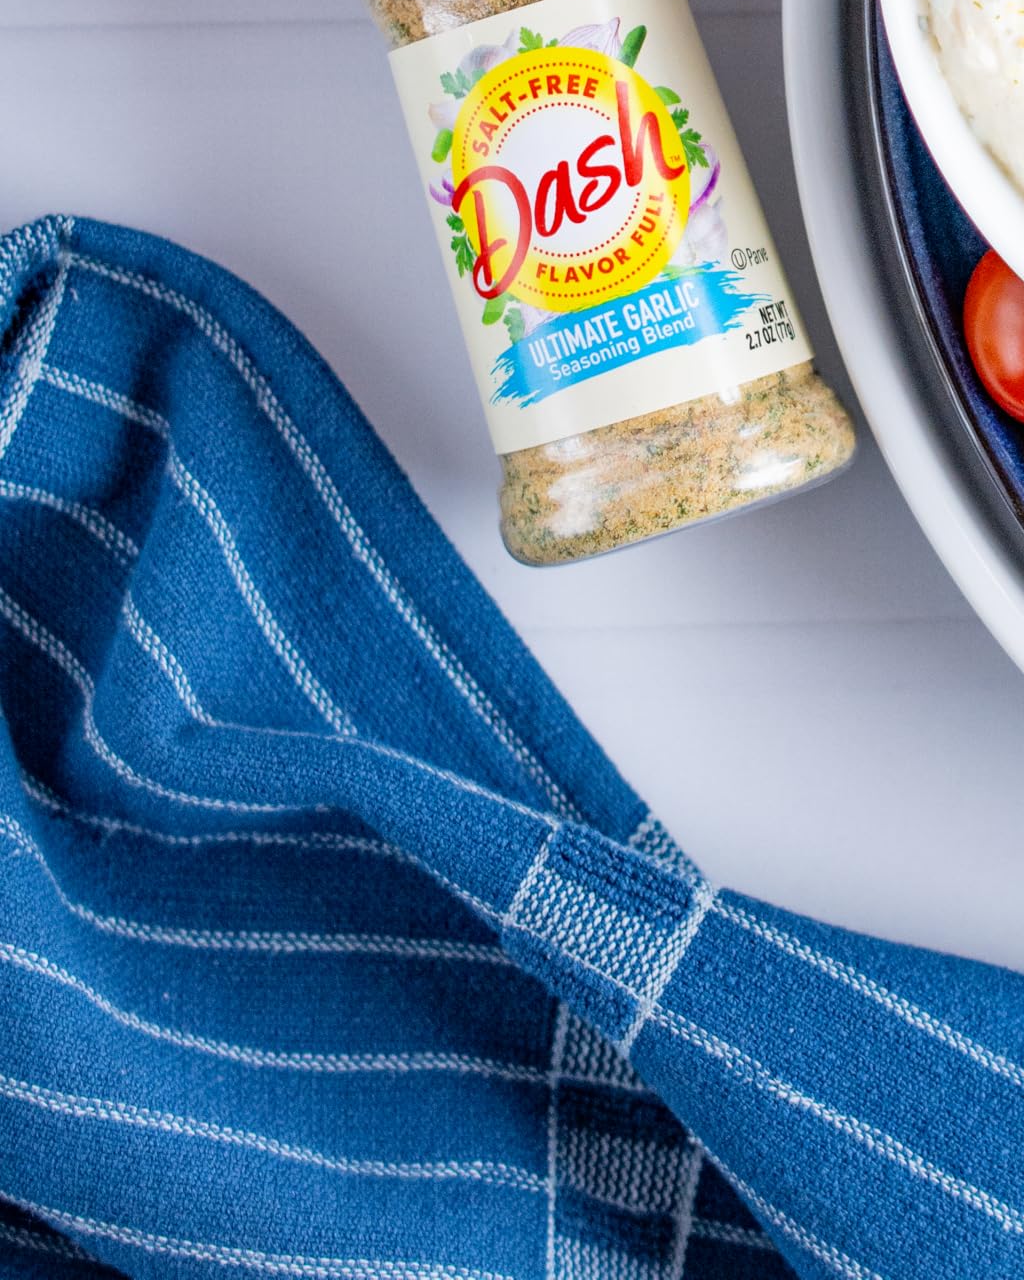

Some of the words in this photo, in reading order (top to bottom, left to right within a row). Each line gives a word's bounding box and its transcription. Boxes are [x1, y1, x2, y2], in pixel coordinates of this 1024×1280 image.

[472, 74, 598, 157] SALT-FREE
[451, 80, 686, 300] Dash
[535, 247, 631, 283] FLAVOR
[631, 192, 665, 247] FULL
[746, 247, 769, 266] Parve
[528, 309, 623, 368] ULTIMATE
[622, 281, 699, 331] GARLIC
[550, 336, 641, 381] Seasoning
[642, 311, 696, 345] Blend
[745, 331, 762, 350] 2.7
[762, 326, 777, 344] OZ
[774, 319, 796, 343] (77g)
[759, 304, 777, 325] NET
[774, 300, 789, 320] WT
